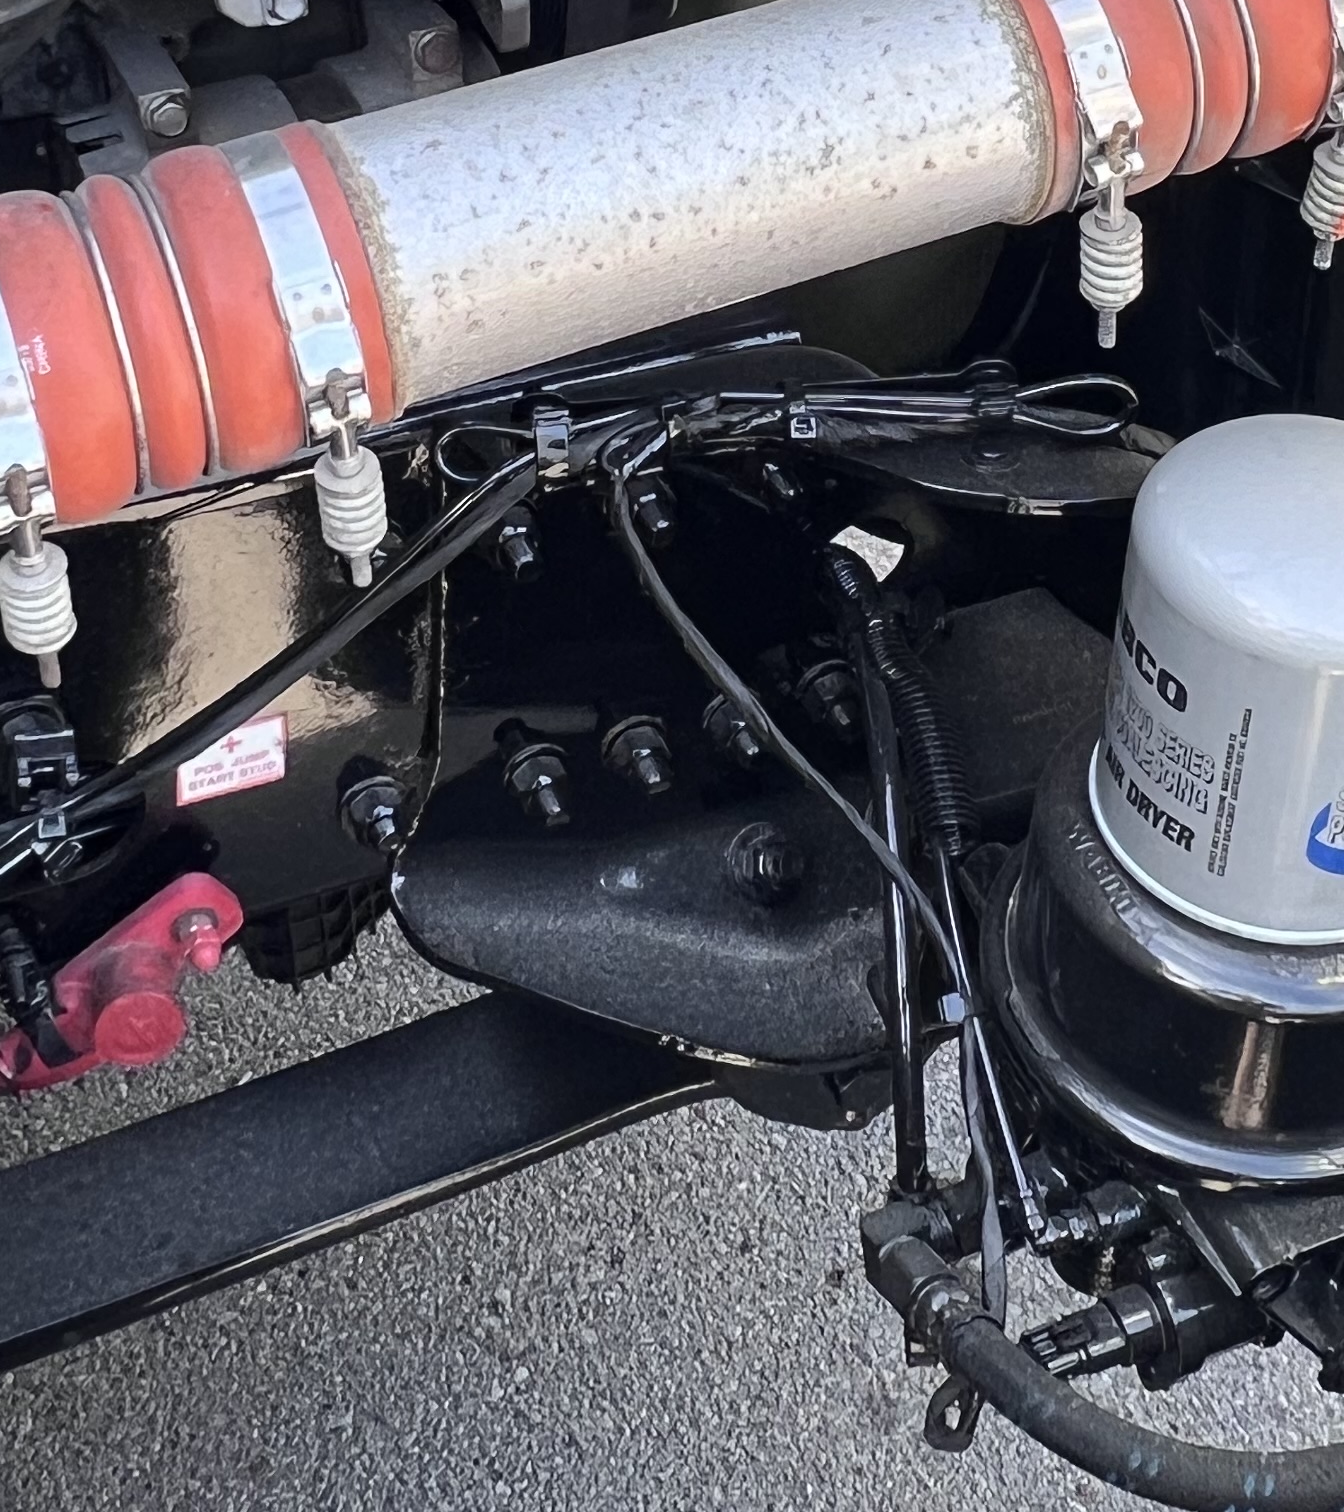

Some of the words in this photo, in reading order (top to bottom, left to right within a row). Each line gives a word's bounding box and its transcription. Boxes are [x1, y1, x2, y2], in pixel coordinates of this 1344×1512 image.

[188, 770, 235, 792] START
[239, 760, 277, 778] STUD
[1125, 775, 1197, 854] DRYER
